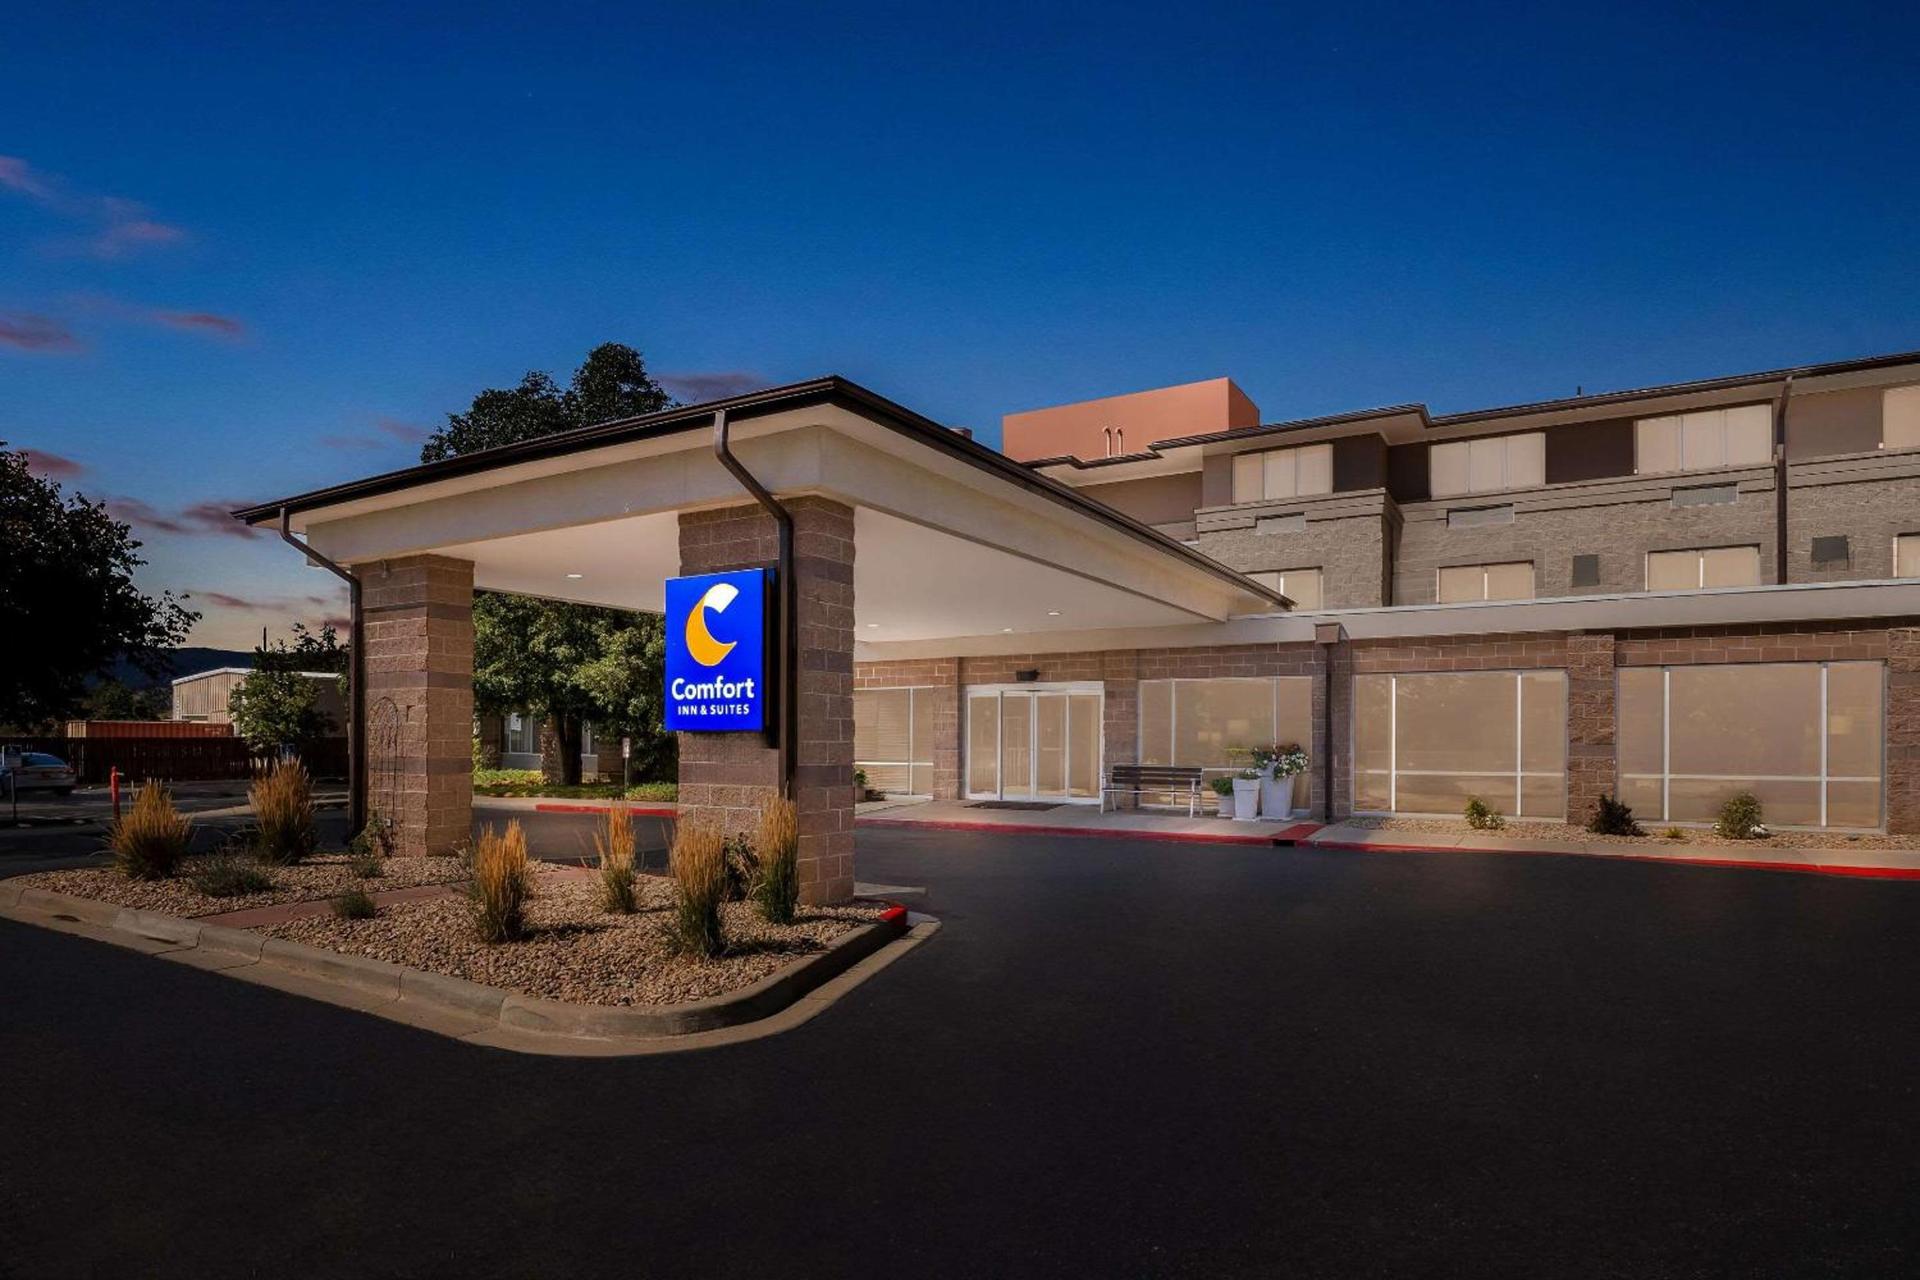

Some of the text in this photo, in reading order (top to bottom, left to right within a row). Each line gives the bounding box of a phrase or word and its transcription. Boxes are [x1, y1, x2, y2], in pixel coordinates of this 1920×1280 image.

[672, 675, 755, 700] Comfort
[678, 704, 750, 716] INN & SUITES
